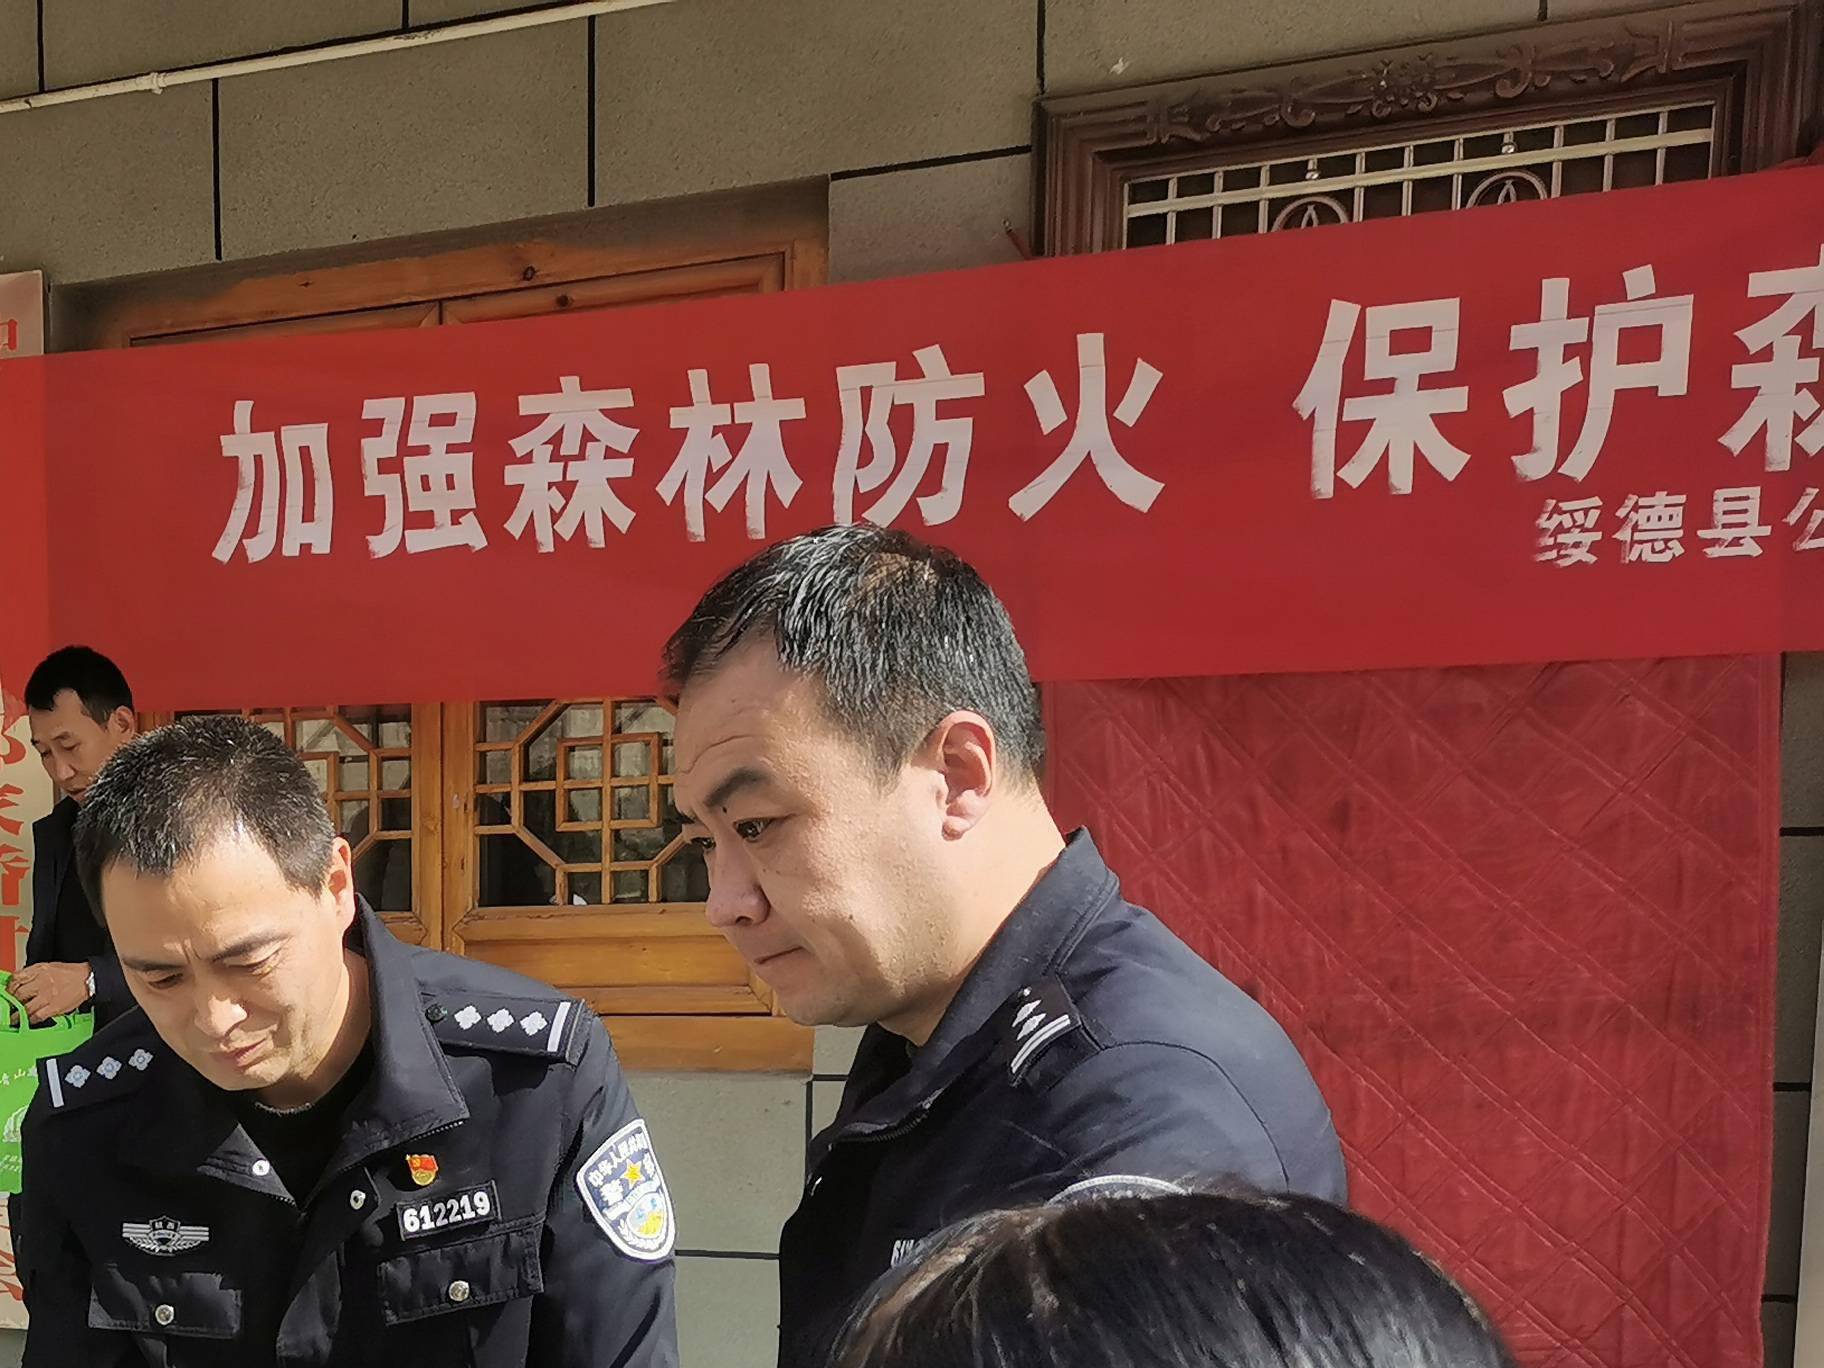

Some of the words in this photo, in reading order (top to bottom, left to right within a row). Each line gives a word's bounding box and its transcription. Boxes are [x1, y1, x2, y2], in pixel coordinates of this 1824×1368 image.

[212, 334, 1165, 564] 加强森林防火
[402, 1192, 491, 1234] 612219
